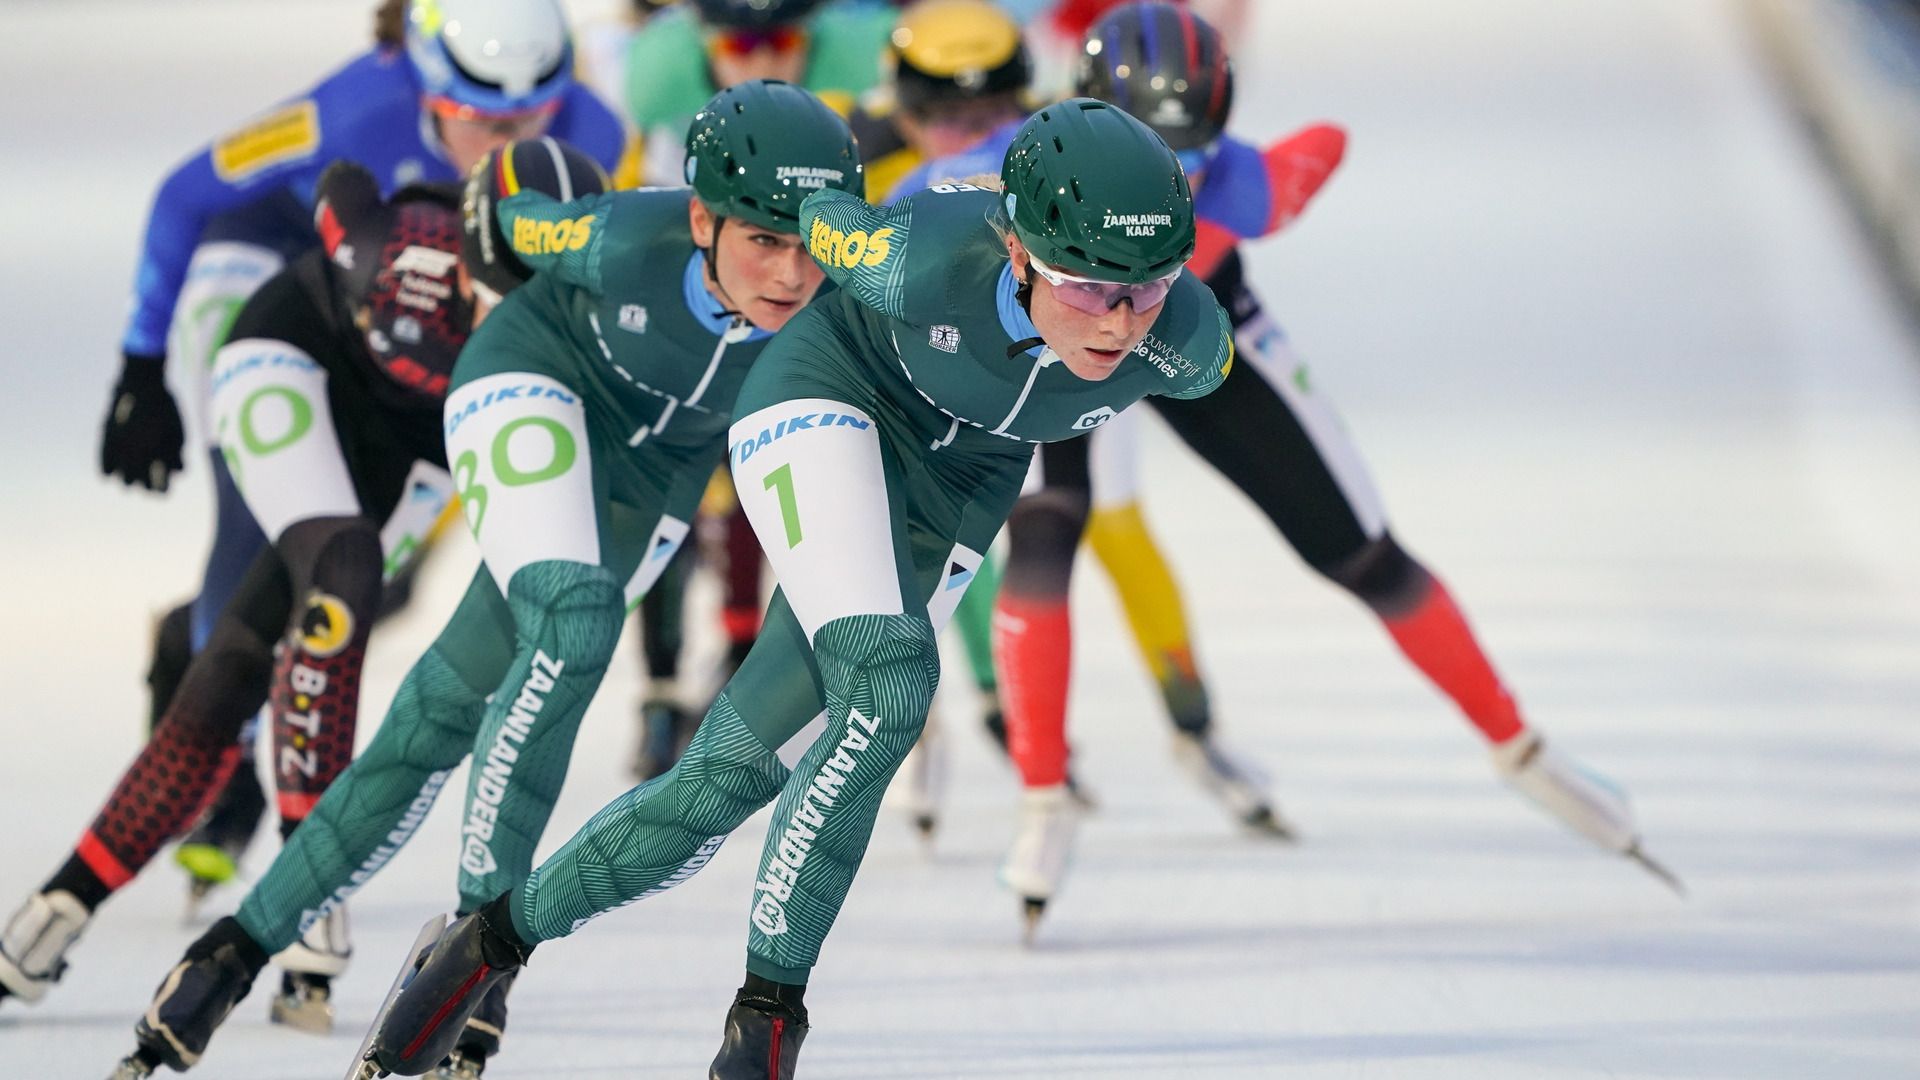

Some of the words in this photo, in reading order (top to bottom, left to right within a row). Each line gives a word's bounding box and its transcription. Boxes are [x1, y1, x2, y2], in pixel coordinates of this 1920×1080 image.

[797, 177, 826, 188] KAAS
[1103, 214, 1172, 228] ZAANLANDER
[1126, 226, 1155, 237] KAAS
[1143, 332, 1201, 378] ouwbedrijf
[1149, 350, 1178, 379] vries
[447, 384, 575, 437] DAIKIN
[741, 413, 870, 465] DAIKIN
[762, 462, 803, 551] 1
[463, 648, 565, 842] ZAANLANDER
[756, 706, 881, 903] ZAANLANDER
